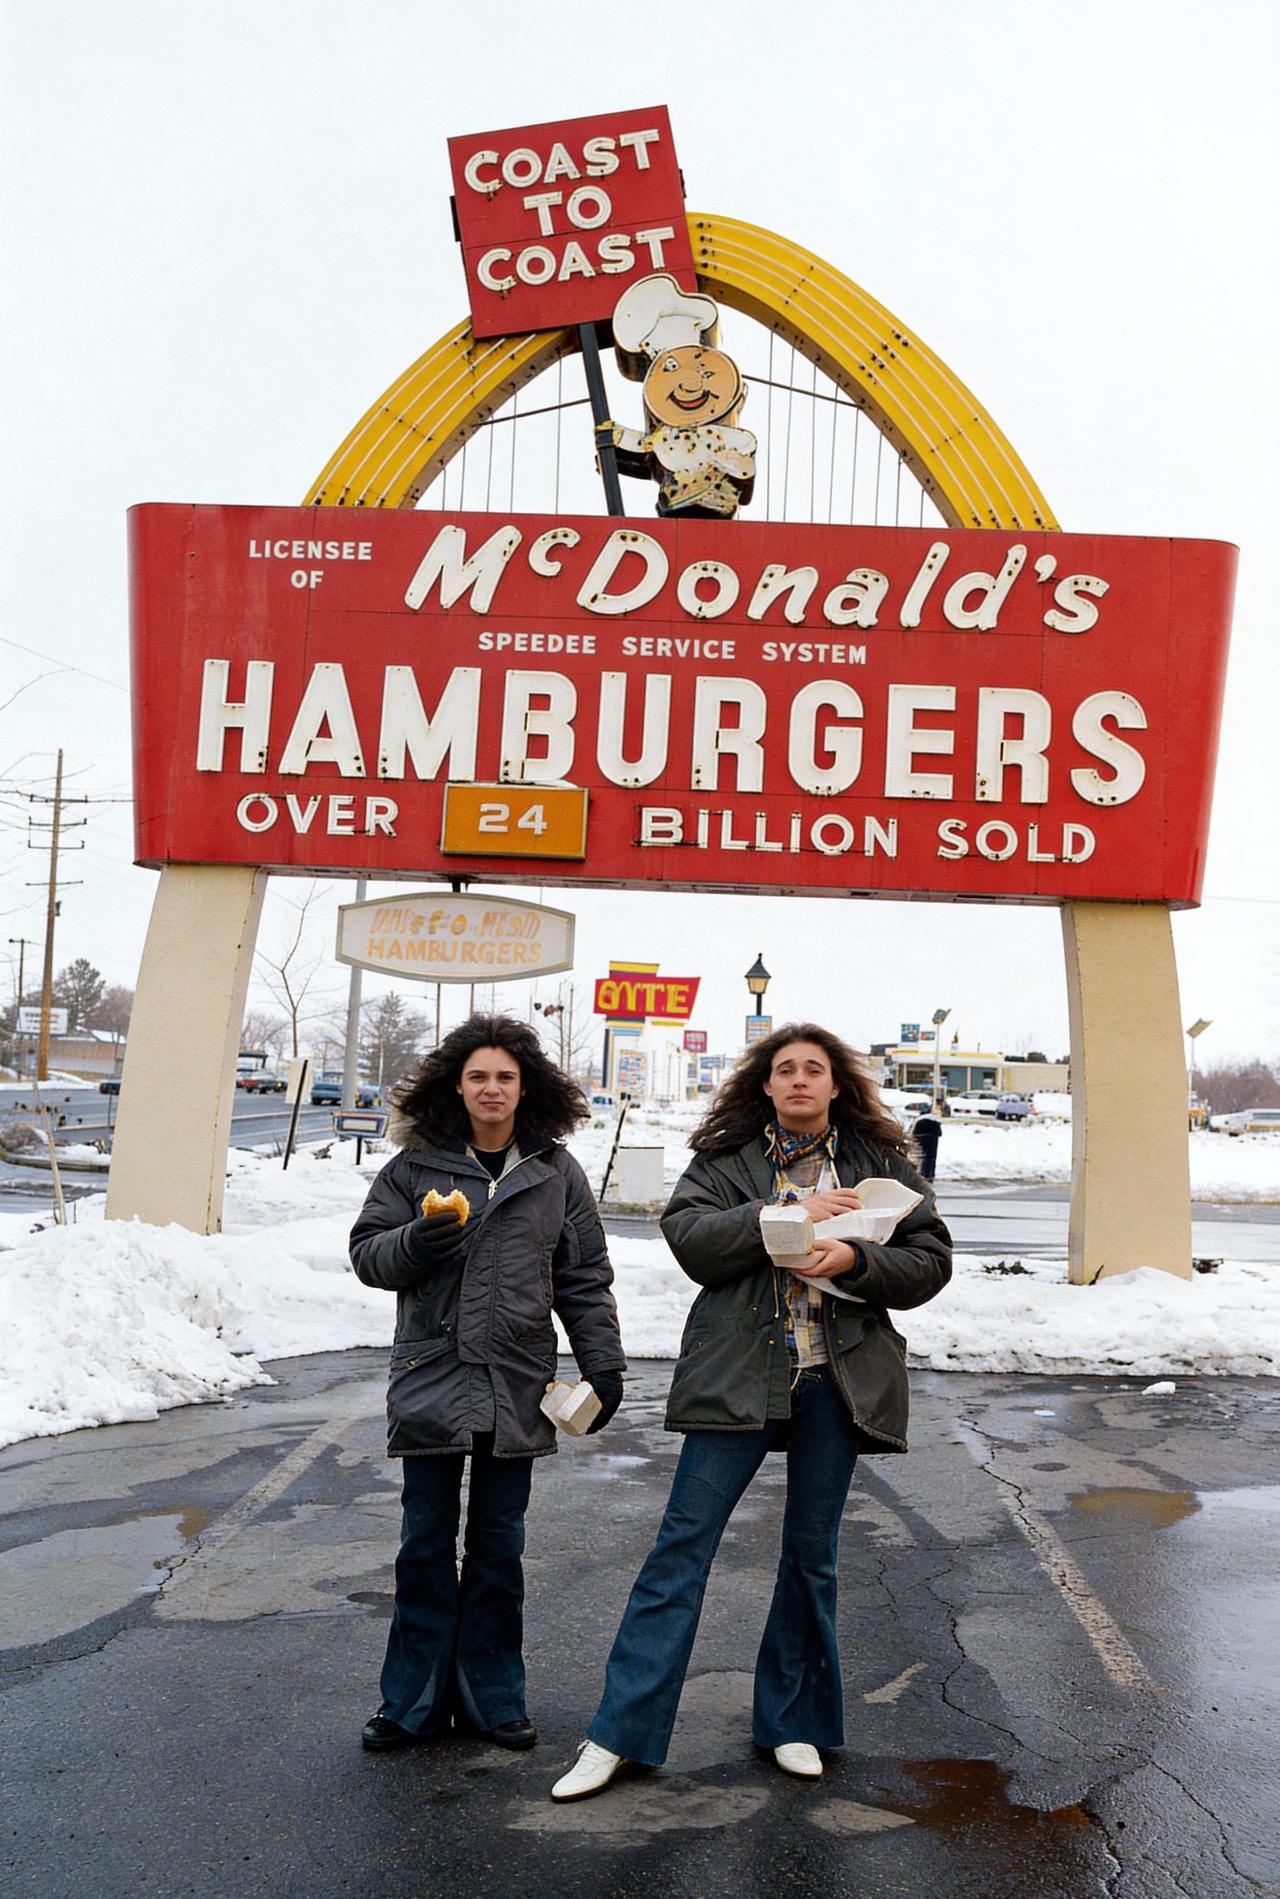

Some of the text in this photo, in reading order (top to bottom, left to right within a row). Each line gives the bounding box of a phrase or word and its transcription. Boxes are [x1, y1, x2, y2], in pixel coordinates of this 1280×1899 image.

[464, 129, 660, 193] COAST
[523, 185, 612, 236] TO
[477, 226, 675, 291] COAST
[249, 539, 373, 561] LICENSEE
[290, 569, 324, 589] OF
[404, 524, 1110, 634] McDonald's
[478, 631, 867, 665] SPEEDEE SERVICE SYSTEM
[196, 658, 1148, 807] HAMBURGERS
[236, 792, 1096, 864] OVER 24 BILLION SOLD
[367, 937, 543, 965] HAMBURGERS
